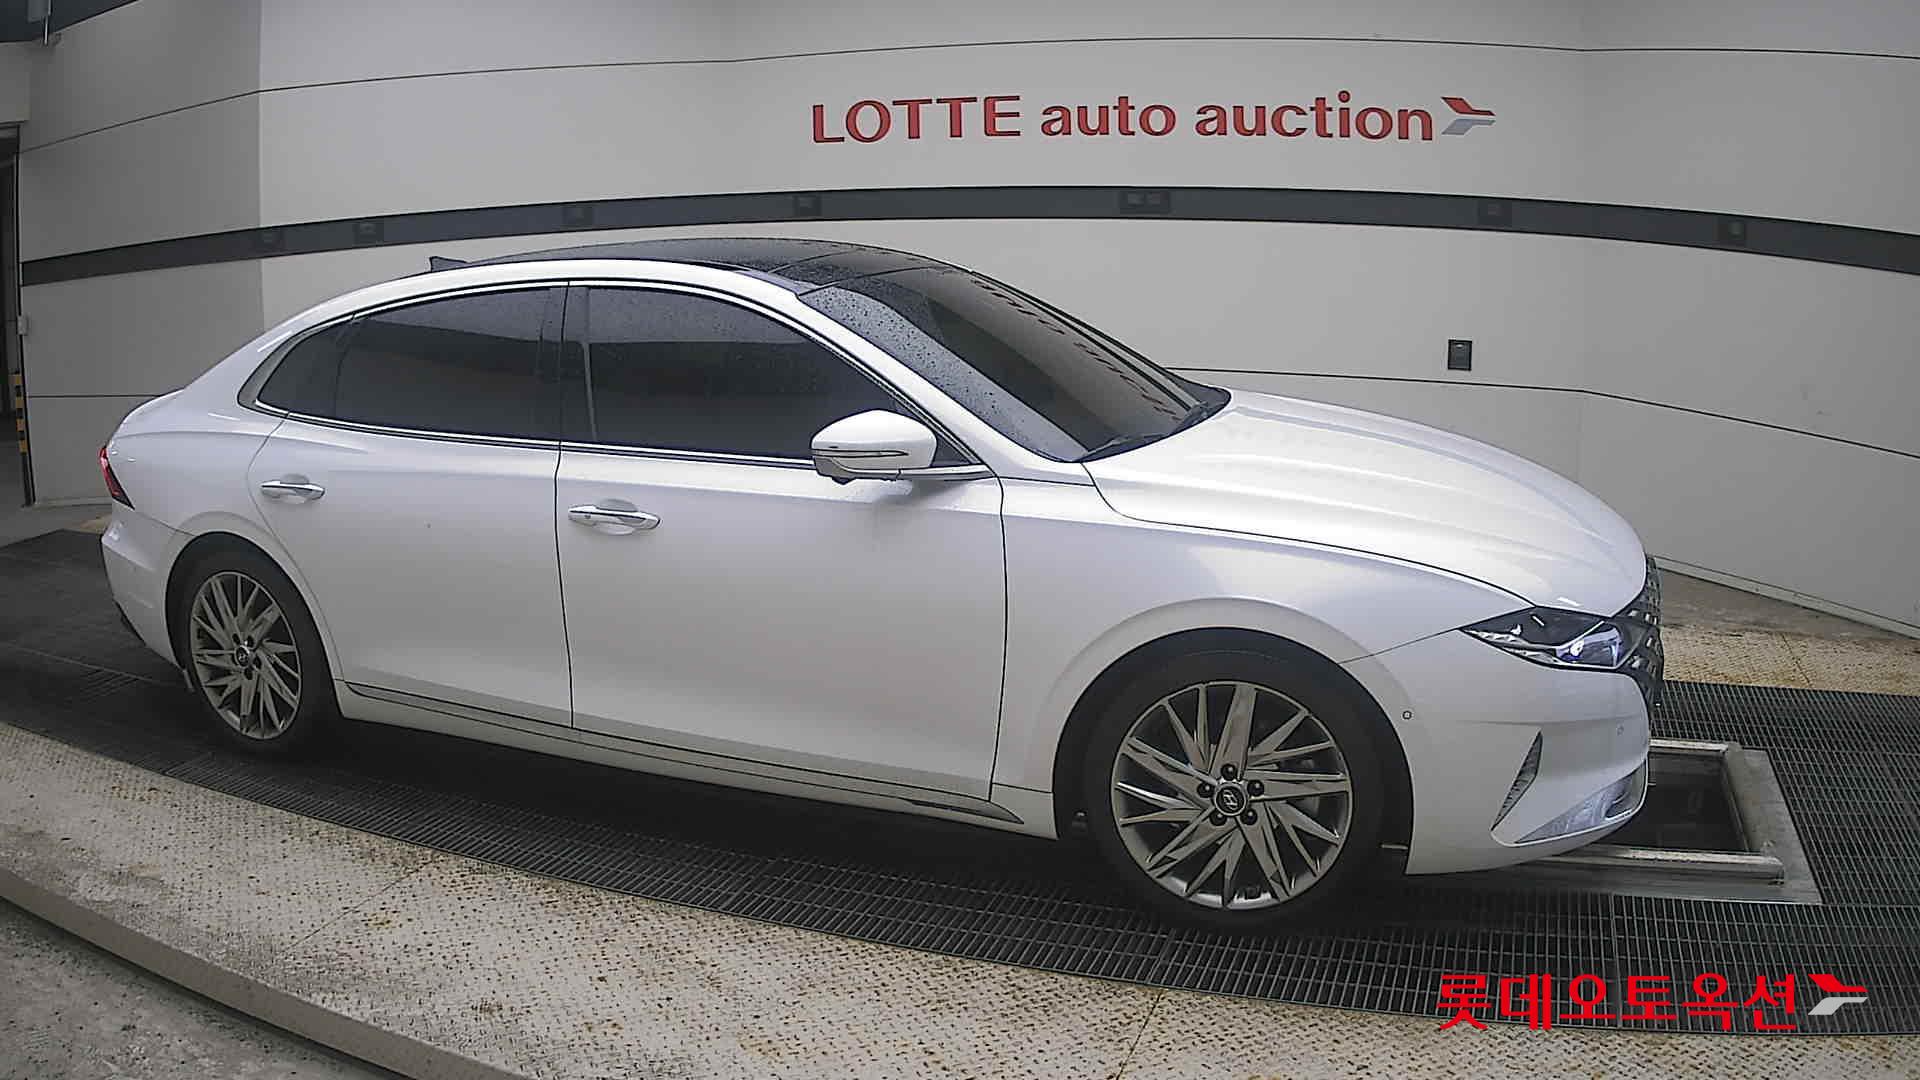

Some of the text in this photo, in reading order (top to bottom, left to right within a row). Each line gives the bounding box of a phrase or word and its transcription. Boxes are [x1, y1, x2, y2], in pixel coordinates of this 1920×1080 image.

[812, 91, 1434, 143] LOTTE auto auction
